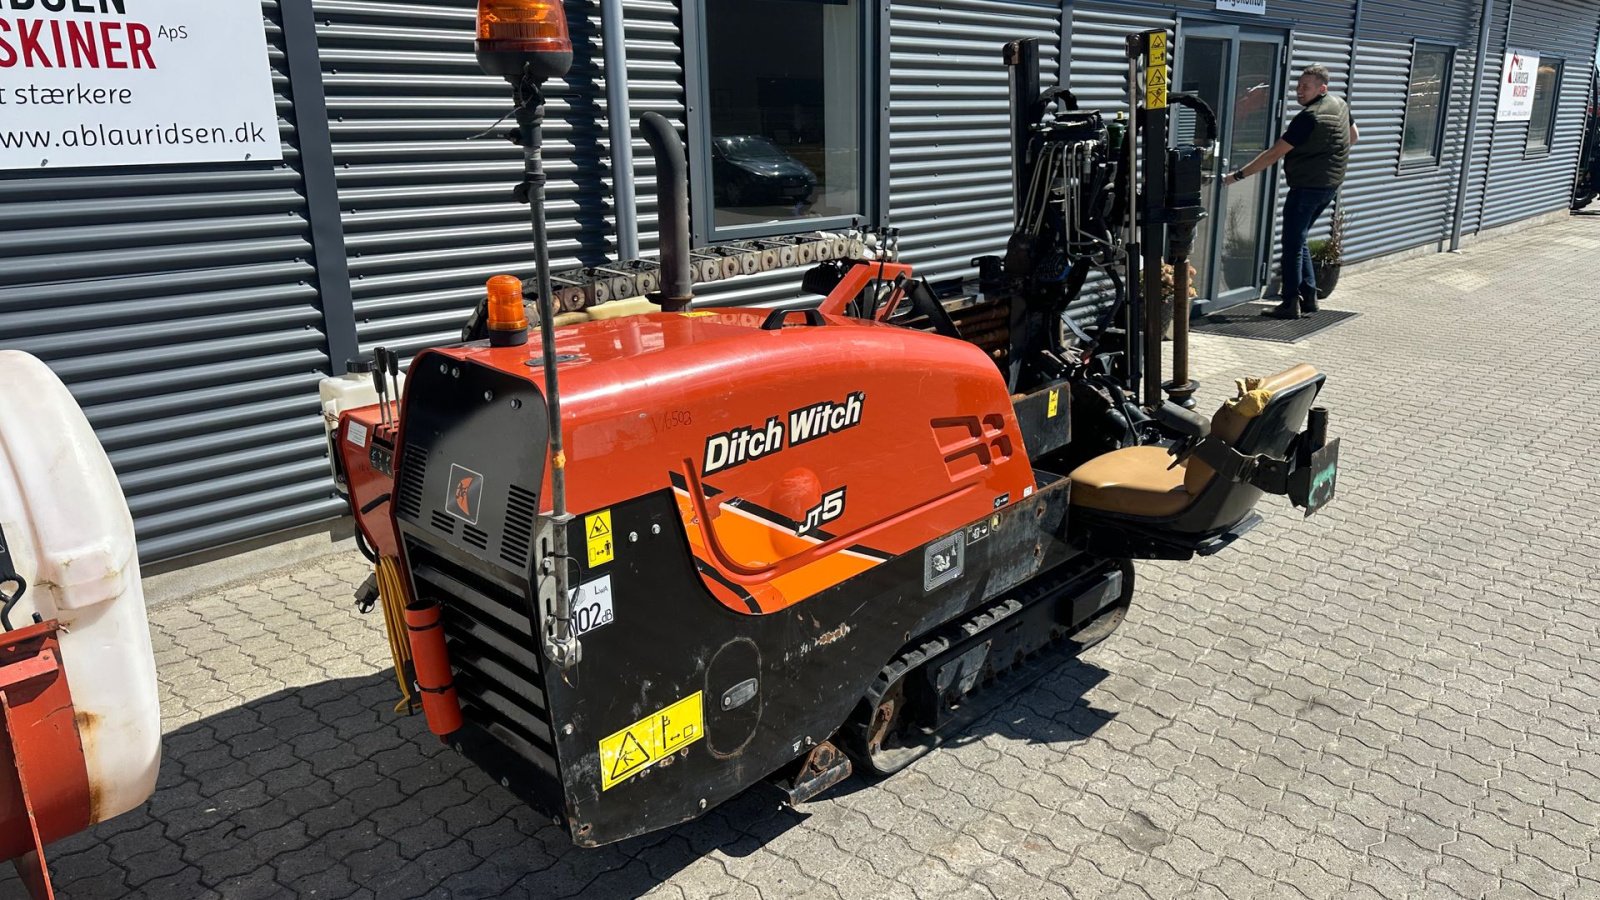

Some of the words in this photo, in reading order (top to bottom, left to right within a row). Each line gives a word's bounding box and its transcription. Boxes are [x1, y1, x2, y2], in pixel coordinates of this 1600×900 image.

[158, 25, 188, 42] ApS
[15, 82, 132, 105] stærkere
[704, 417, 783, 474] Ditch
[799, 490, 843, 534] JT5
